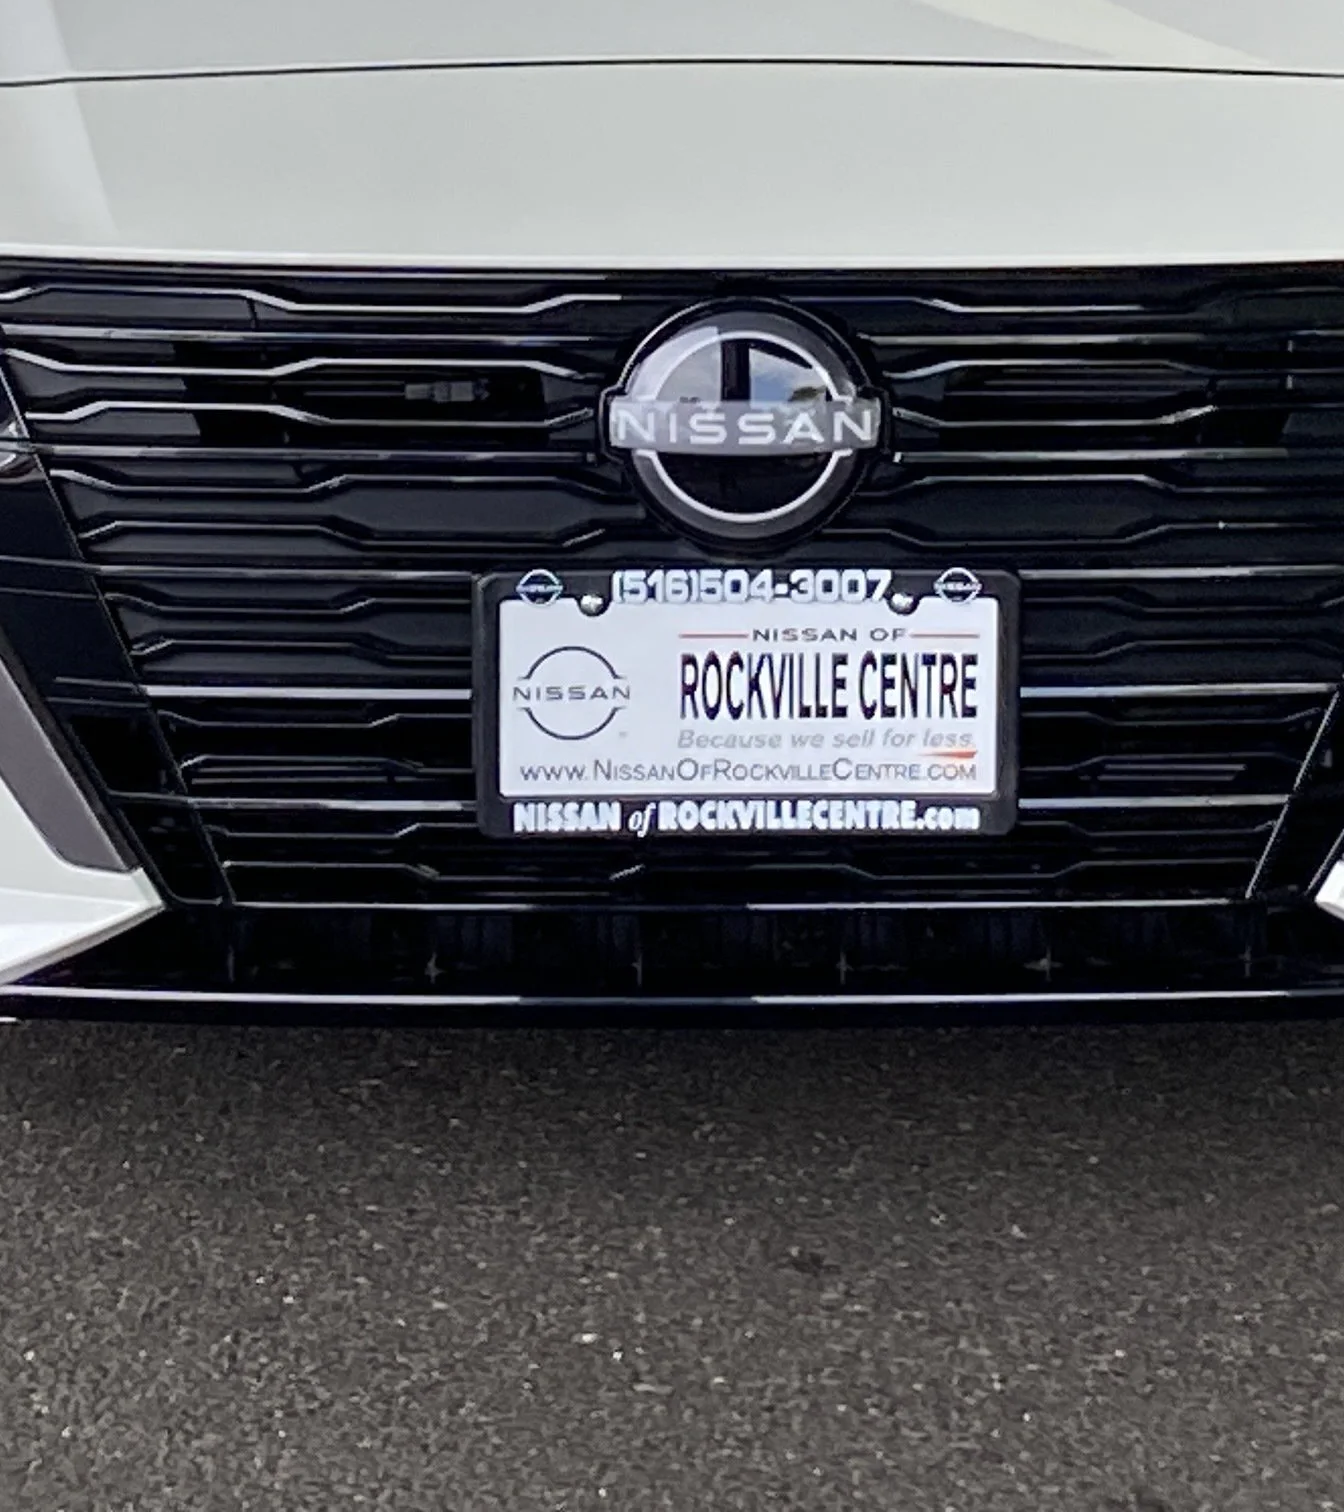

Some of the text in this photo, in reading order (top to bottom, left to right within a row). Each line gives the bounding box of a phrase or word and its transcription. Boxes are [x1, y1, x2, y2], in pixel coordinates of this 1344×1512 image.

[617, 408, 875, 445] NISSAN
[612, 568, 892, 605] (516)504-3007
[752, 628, 907, 642] NISSAN OF
[512, 686, 631, 702] NISSAN
[679, 651, 978, 720] ROCKVILLE CENTRE
[677, 729, 782, 749] Because
[790, 734, 825, 748] we
[832, 728, 876, 748] sell
[882, 728, 917, 749] for
[513, 799, 981, 838] NISSAN of ROCKVILLECENTRE.com
